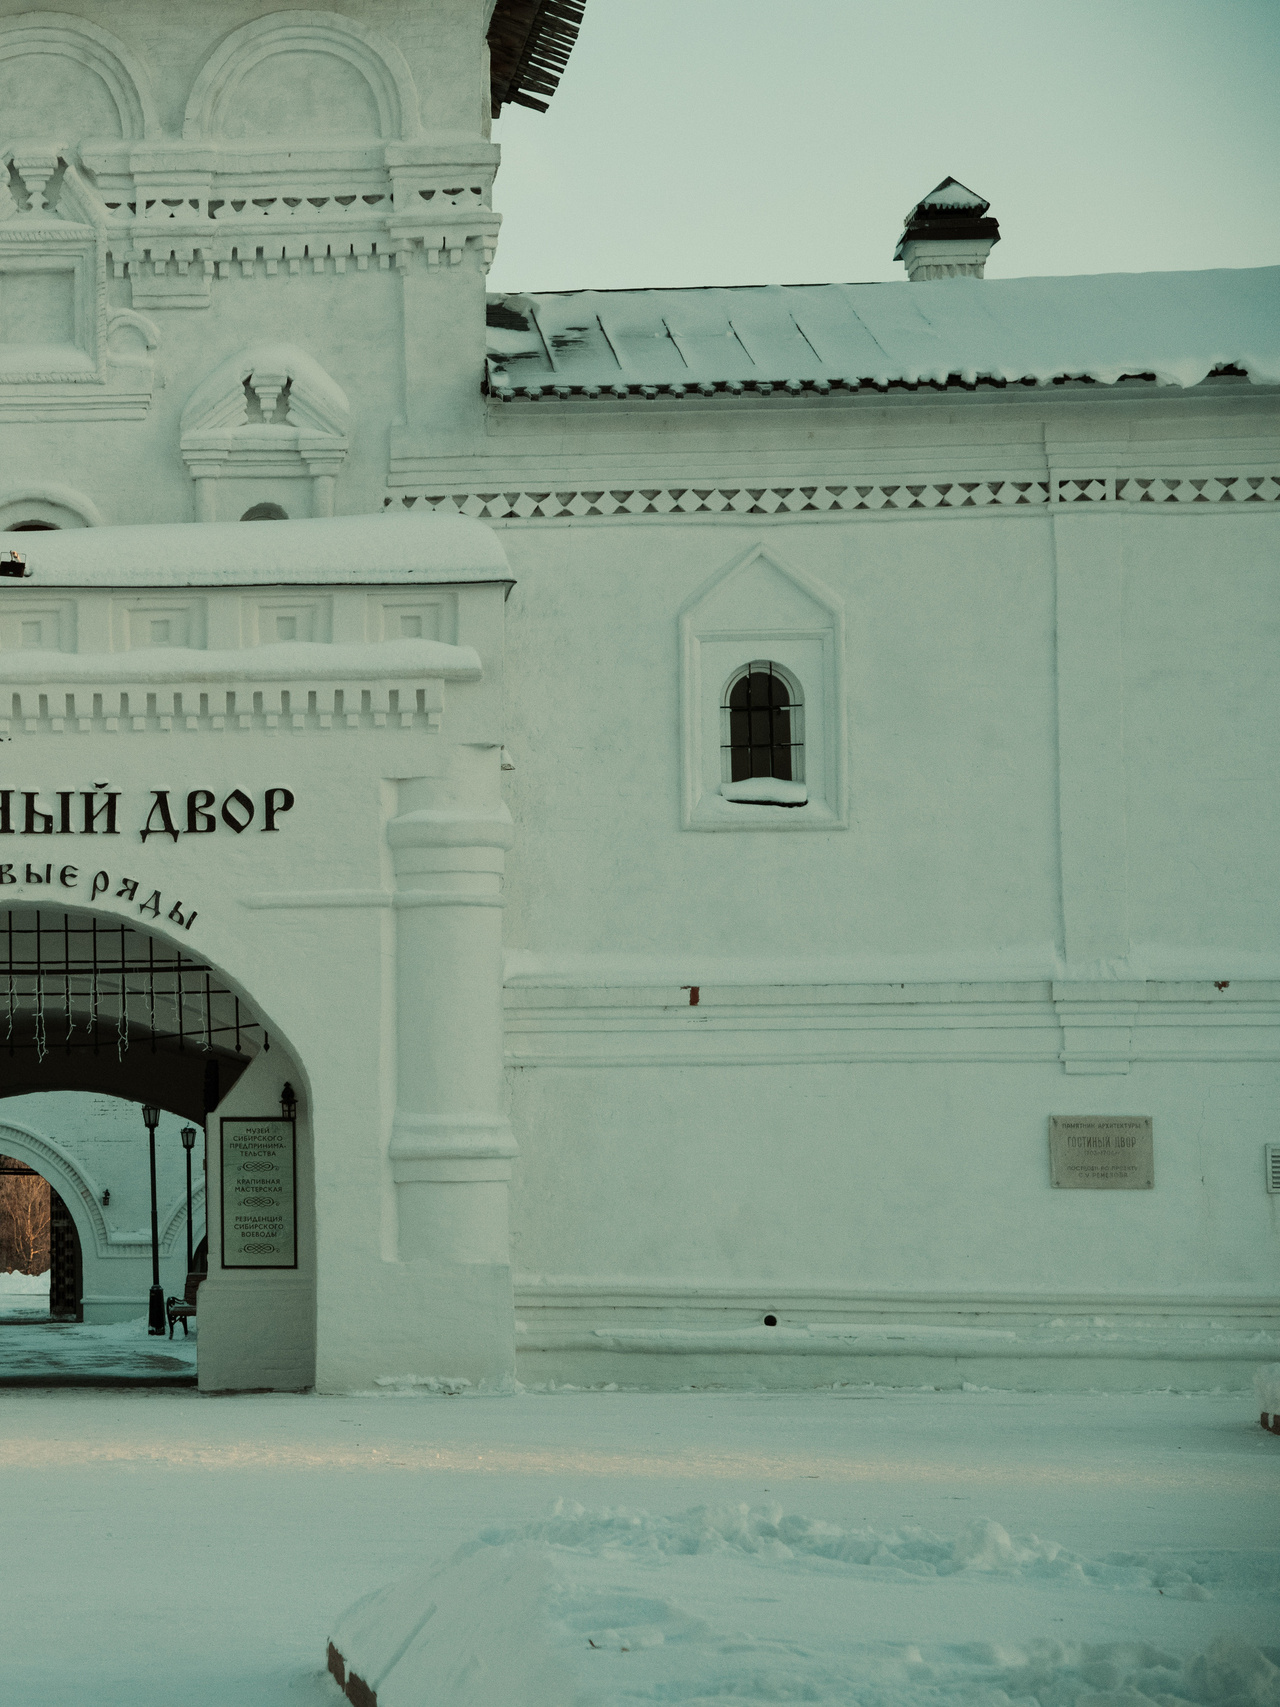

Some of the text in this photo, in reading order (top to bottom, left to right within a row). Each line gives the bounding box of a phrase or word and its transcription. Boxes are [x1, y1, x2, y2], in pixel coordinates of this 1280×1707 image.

[139, 787, 296, 843] ДВОР
[1067, 1136, 1137, 1148] ГОСТИНЫЙ ДВОР
